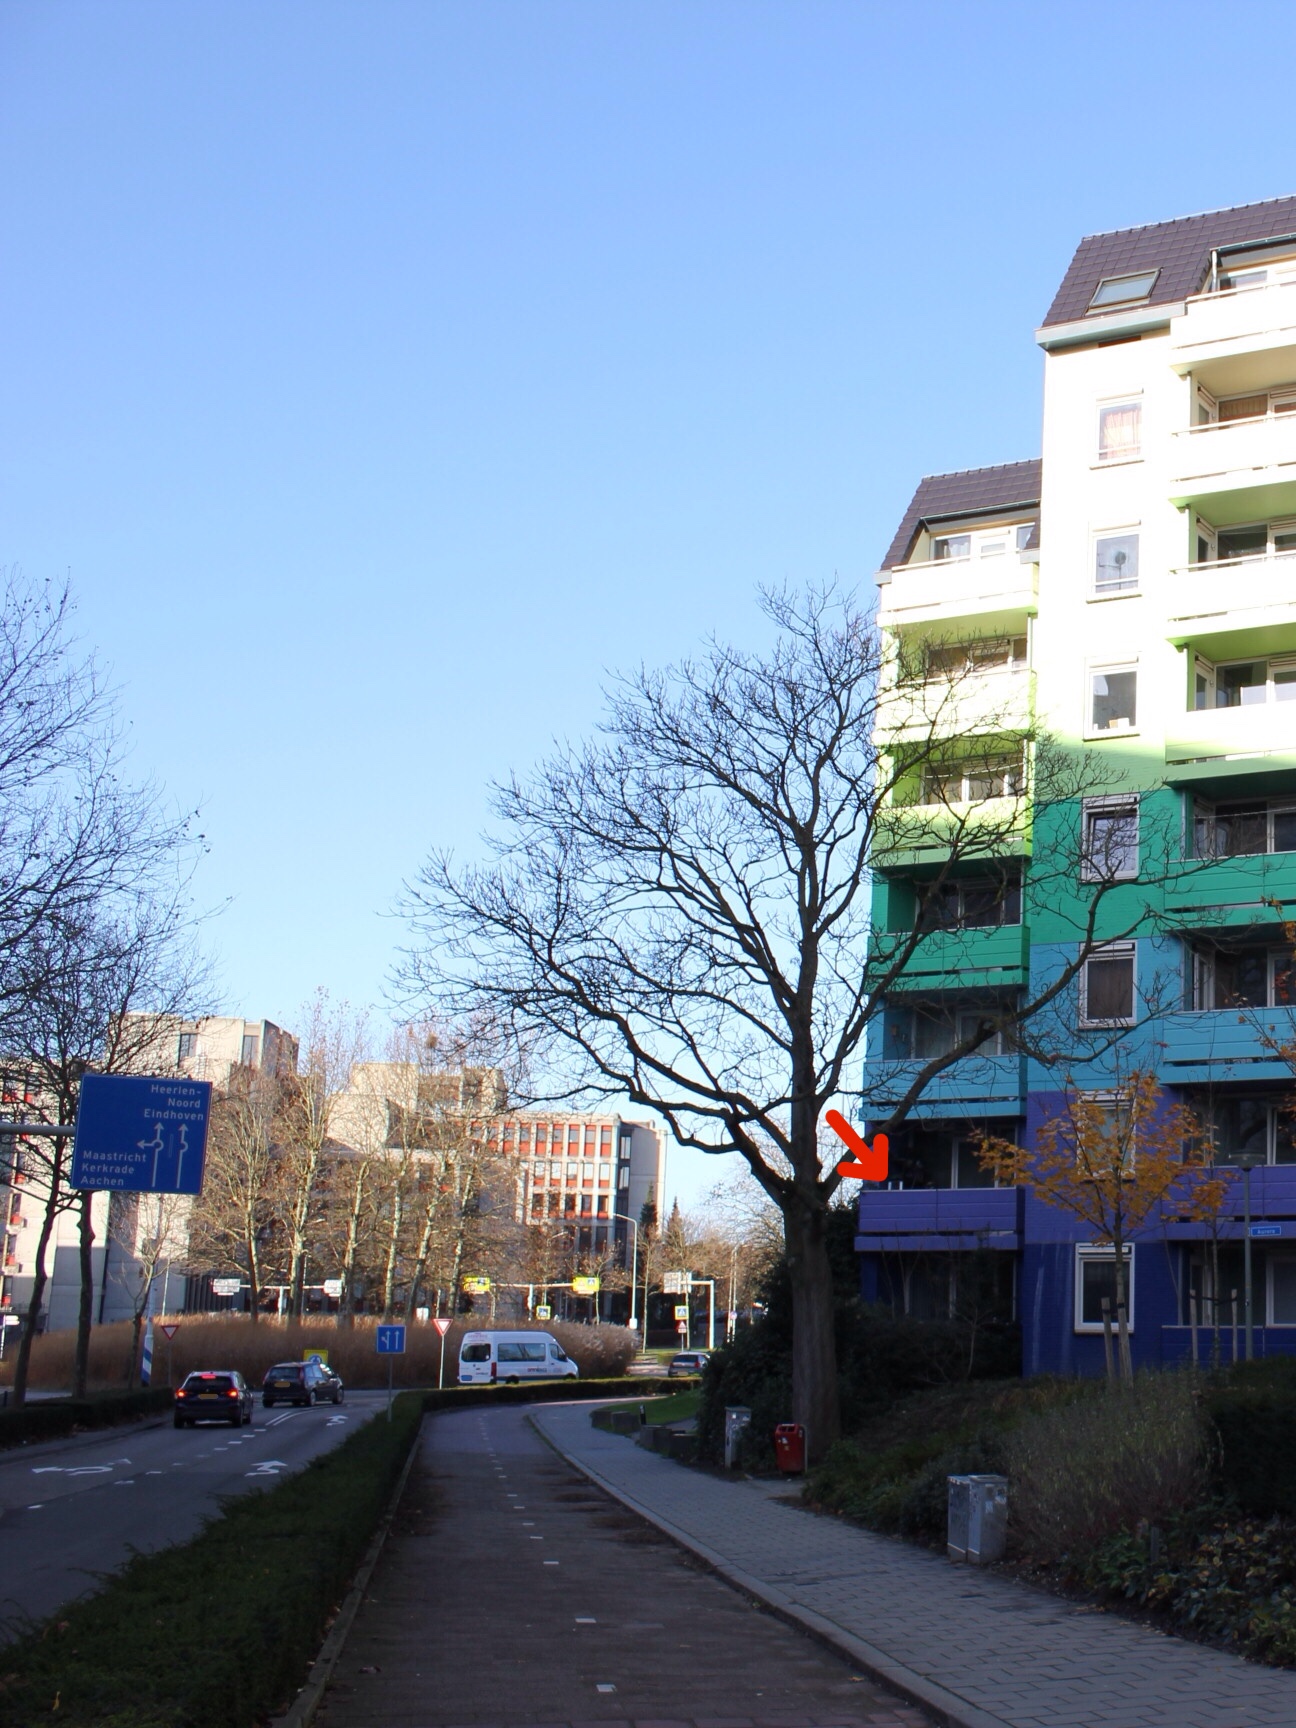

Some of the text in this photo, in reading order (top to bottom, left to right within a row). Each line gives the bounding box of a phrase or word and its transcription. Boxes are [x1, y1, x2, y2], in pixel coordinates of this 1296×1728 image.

[167, 1098, 201, 1108] Noord
[143, 1108, 204, 1121] Eindhoven
[83, 1150, 147, 1162] Maastricht
[81, 1163, 135, 1174] Kerkrade
[80, 1175, 124, 1186] Aachen
